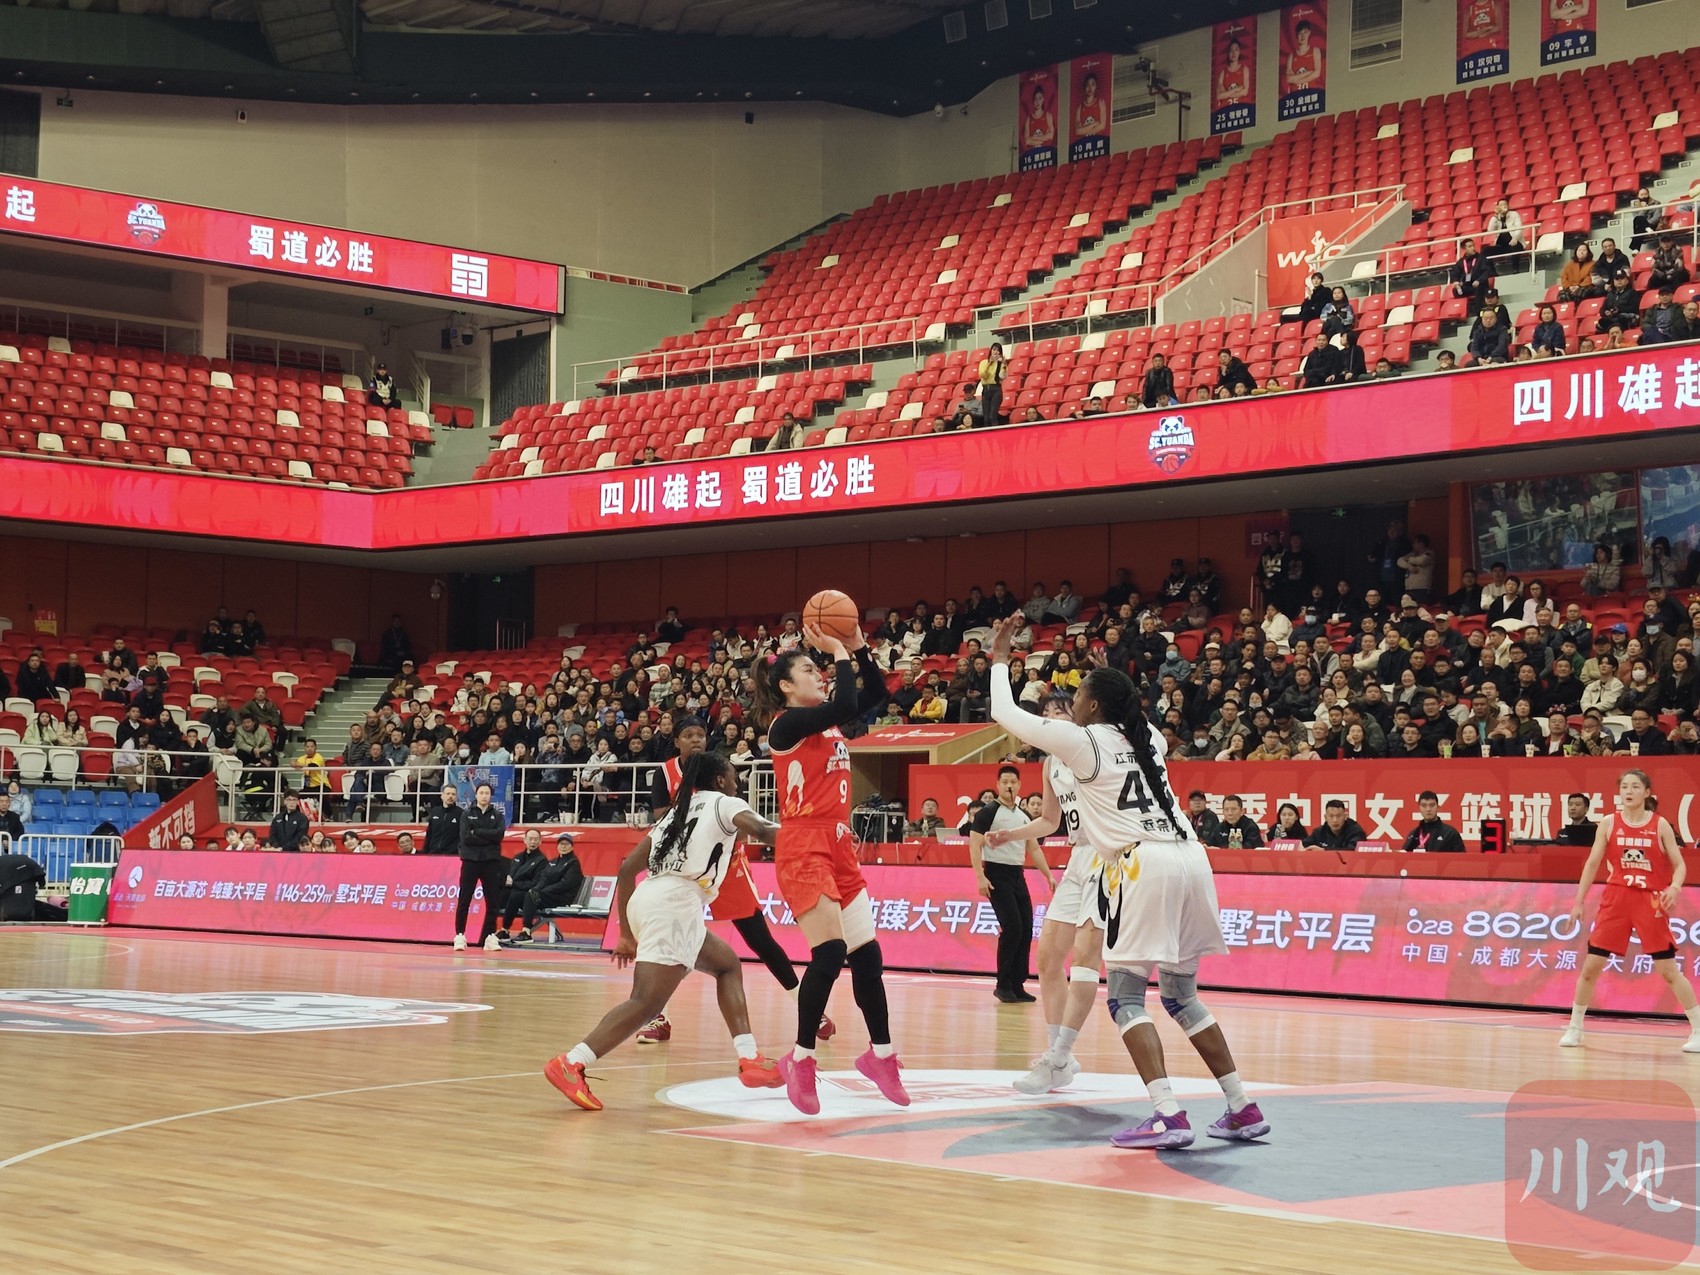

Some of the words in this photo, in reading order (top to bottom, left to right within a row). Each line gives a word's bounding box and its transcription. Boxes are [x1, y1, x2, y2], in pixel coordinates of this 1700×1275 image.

[1549, 41, 1561, 51] 09
[1464, 61, 1474, 69] 18
[1285, 99, 1294, 108] 30
[1217, 113, 1226, 122] 25
[1075, 144, 1083, 153] 10
[1024, 156, 1032, 164] 16
[5, 185, 36, 222] 起
[249, 224, 374, 273] 蜀道必胜
[599, 470, 721, 517] 四川雄起
[740, 455, 875, 505] 蜀道必胜
[839, 779, 848, 804] 9
[153, 879, 208, 899] 百亩大源芯
[335, 883, 388, 905] 墅式平层
[411, 884, 446, 899] 8620
[1220, 908, 1376, 953] 墅式平层
[1463, 910, 1581, 941] 8620
